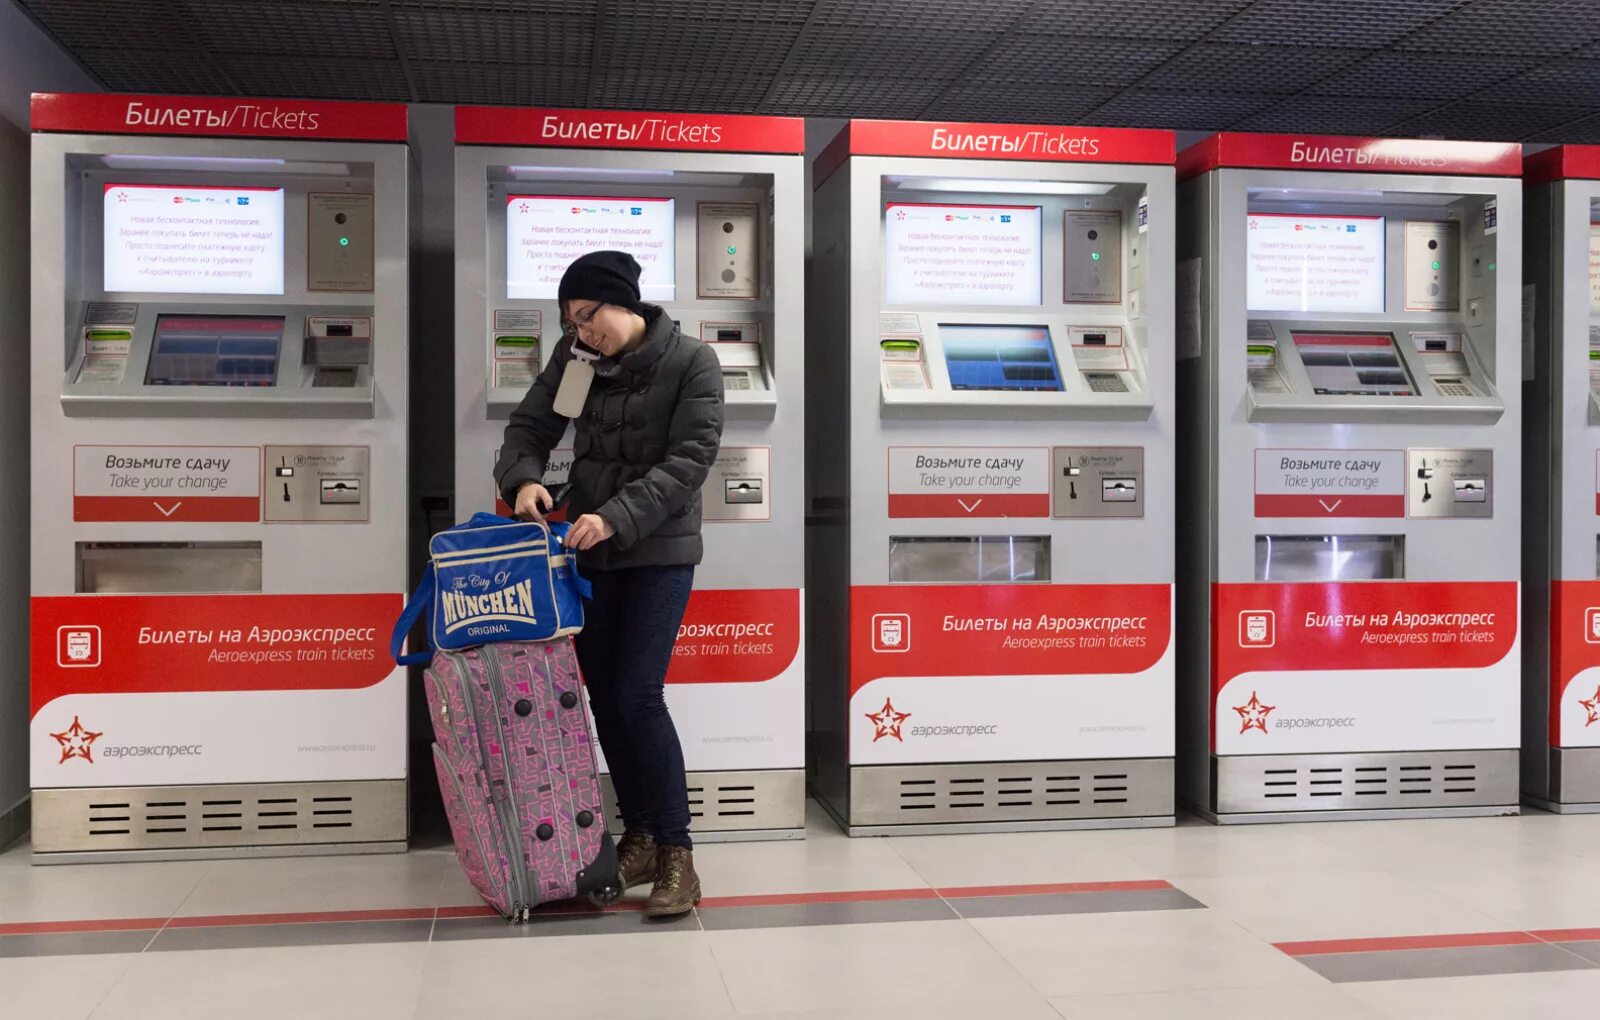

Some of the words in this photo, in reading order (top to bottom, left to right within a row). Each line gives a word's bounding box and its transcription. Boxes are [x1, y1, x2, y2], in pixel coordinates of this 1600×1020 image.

[125, 102, 319, 130] Билеты/Tickets
[541, 116, 722, 143] Билеты/Tickets
[931, 128, 1100, 156] Билеты/Tickets
[105, 455, 182, 469] Возьмите
[184, 456, 231, 472] сдачу
[915, 455, 981, 469] Возьмите
[985, 457, 1024, 471] сдачу
[1280, 457, 1342, 470] Возьмите
[1345, 459, 1381, 473] сдачу
[109, 474, 140, 488] Take
[142, 476, 175, 491] your
[178, 474, 228, 491] change
[919, 473, 946, 486] Take
[948, 475, 976, 489] your
[978, 473, 1022, 489] change
[1283, 474, 1309, 487] Take
[1310, 476, 1336, 490] your
[1338, 474, 1379, 489] change
[451, 576, 468, 590] The
[468, 575, 491, 591] City
[494, 570, 512, 586] Of
[441, 578, 535, 626] MÜNCHEN
[943, 615, 1008, 631] Билеты
[1012, 617, 1032, 630] на
[1037, 615, 1147, 633] Аэроэкспресс
[1305, 612, 1365, 627] Билеты
[1370, 613, 1387, 626] на
[1393, 611, 1495, 629] Аэроэкспресс
[138, 627, 212, 644] Билеты
[219, 630, 240, 643] на
[247, 626, 376, 646] Аэроэкспресс
[467, 623, 510, 637] ORIGINAL
[676, 623, 775, 640] роэкспресс
[1361, 631, 1428, 645] Aeroexpress
[1432, 631, 1456, 643] train
[1459, 630, 1495, 643] tickets
[701, 642, 729, 656] train
[733, 641, 774, 655] tickets
[1002, 636, 1075, 650] Aeroexpress
[1079, 635, 1106, 647] train
[1110, 634, 1146, 647] tickets
[208, 649, 292, 665] Aeroexpress
[296, 648, 327, 662] train
[331, 647, 375, 661] tickets
[911, 724, 997, 738] аэроэкспресс
[1275, 717, 1356, 730] аэроэкспресс
[103, 744, 203, 760] аэроэкспресс
